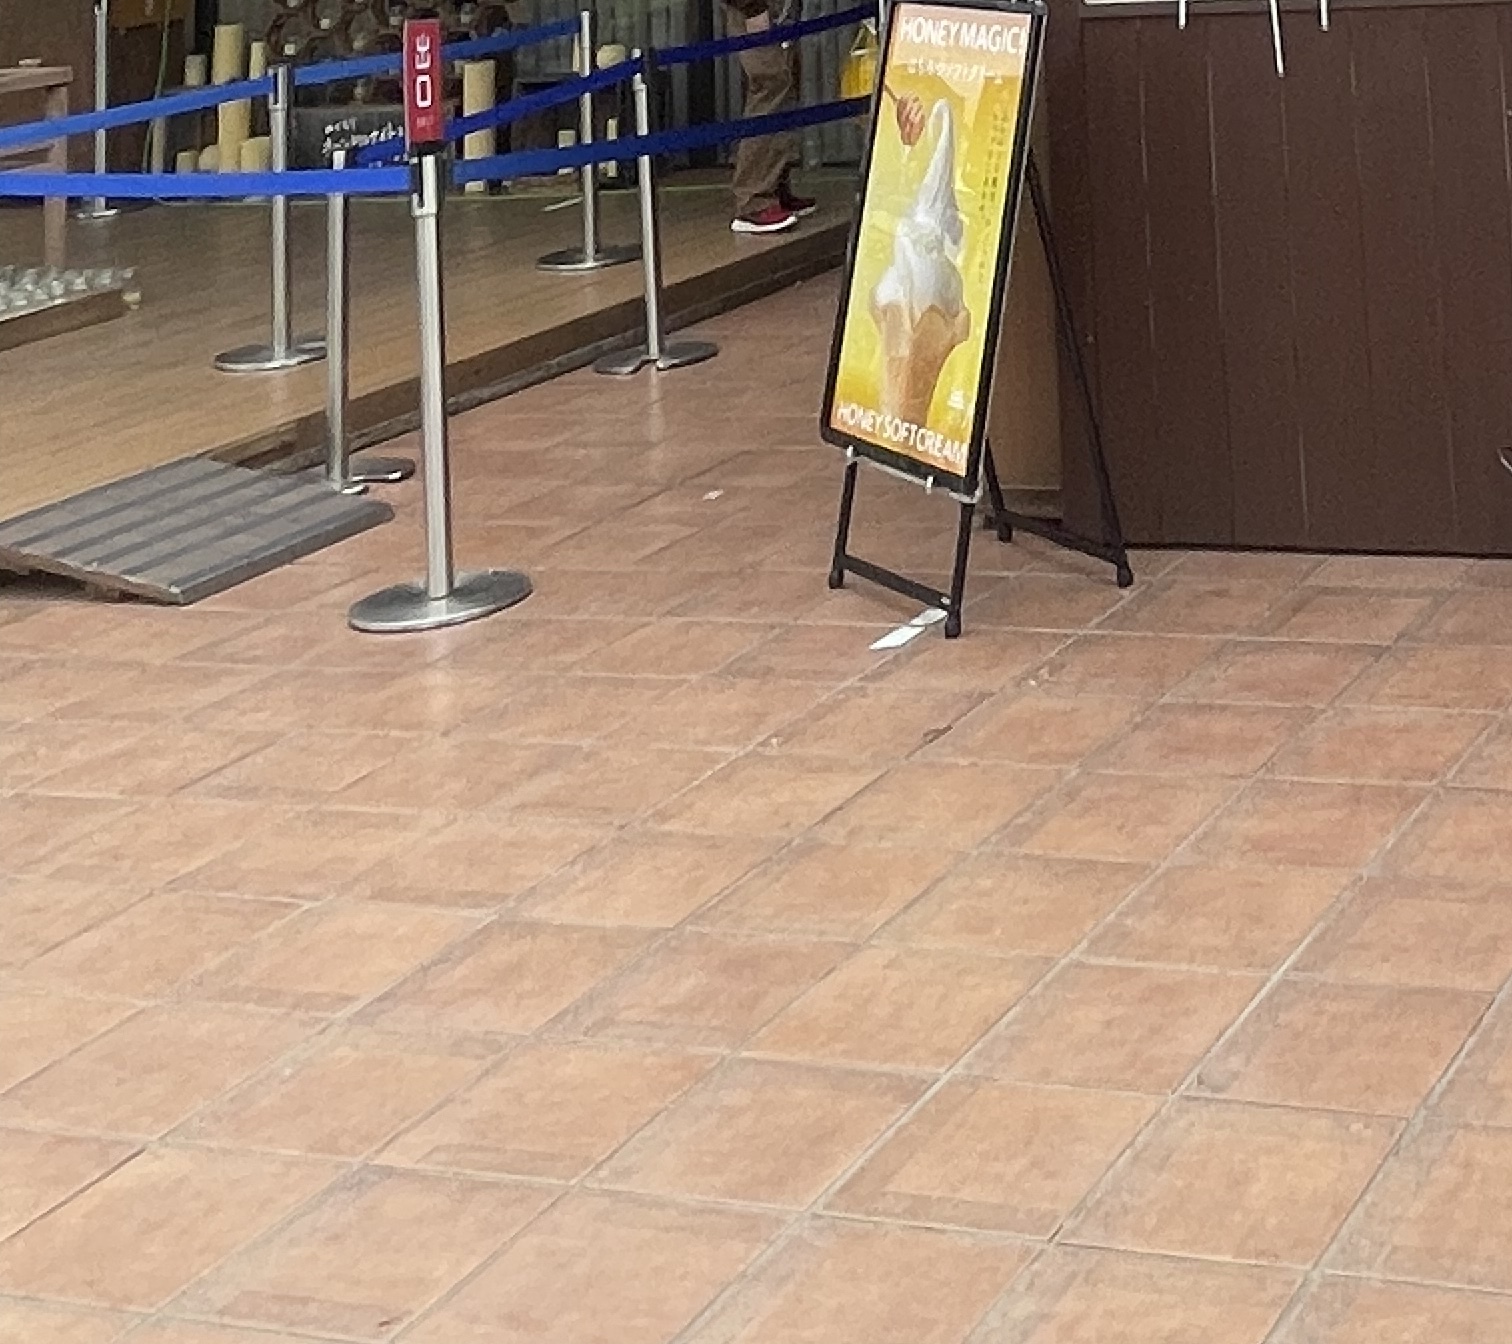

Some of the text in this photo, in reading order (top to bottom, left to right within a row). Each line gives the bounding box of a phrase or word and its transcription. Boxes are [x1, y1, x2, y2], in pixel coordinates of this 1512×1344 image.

[900, 16, 959, 48] HONEY
[836, 401, 884, 434] HONEY
[882, 414, 918, 446] SOFT
